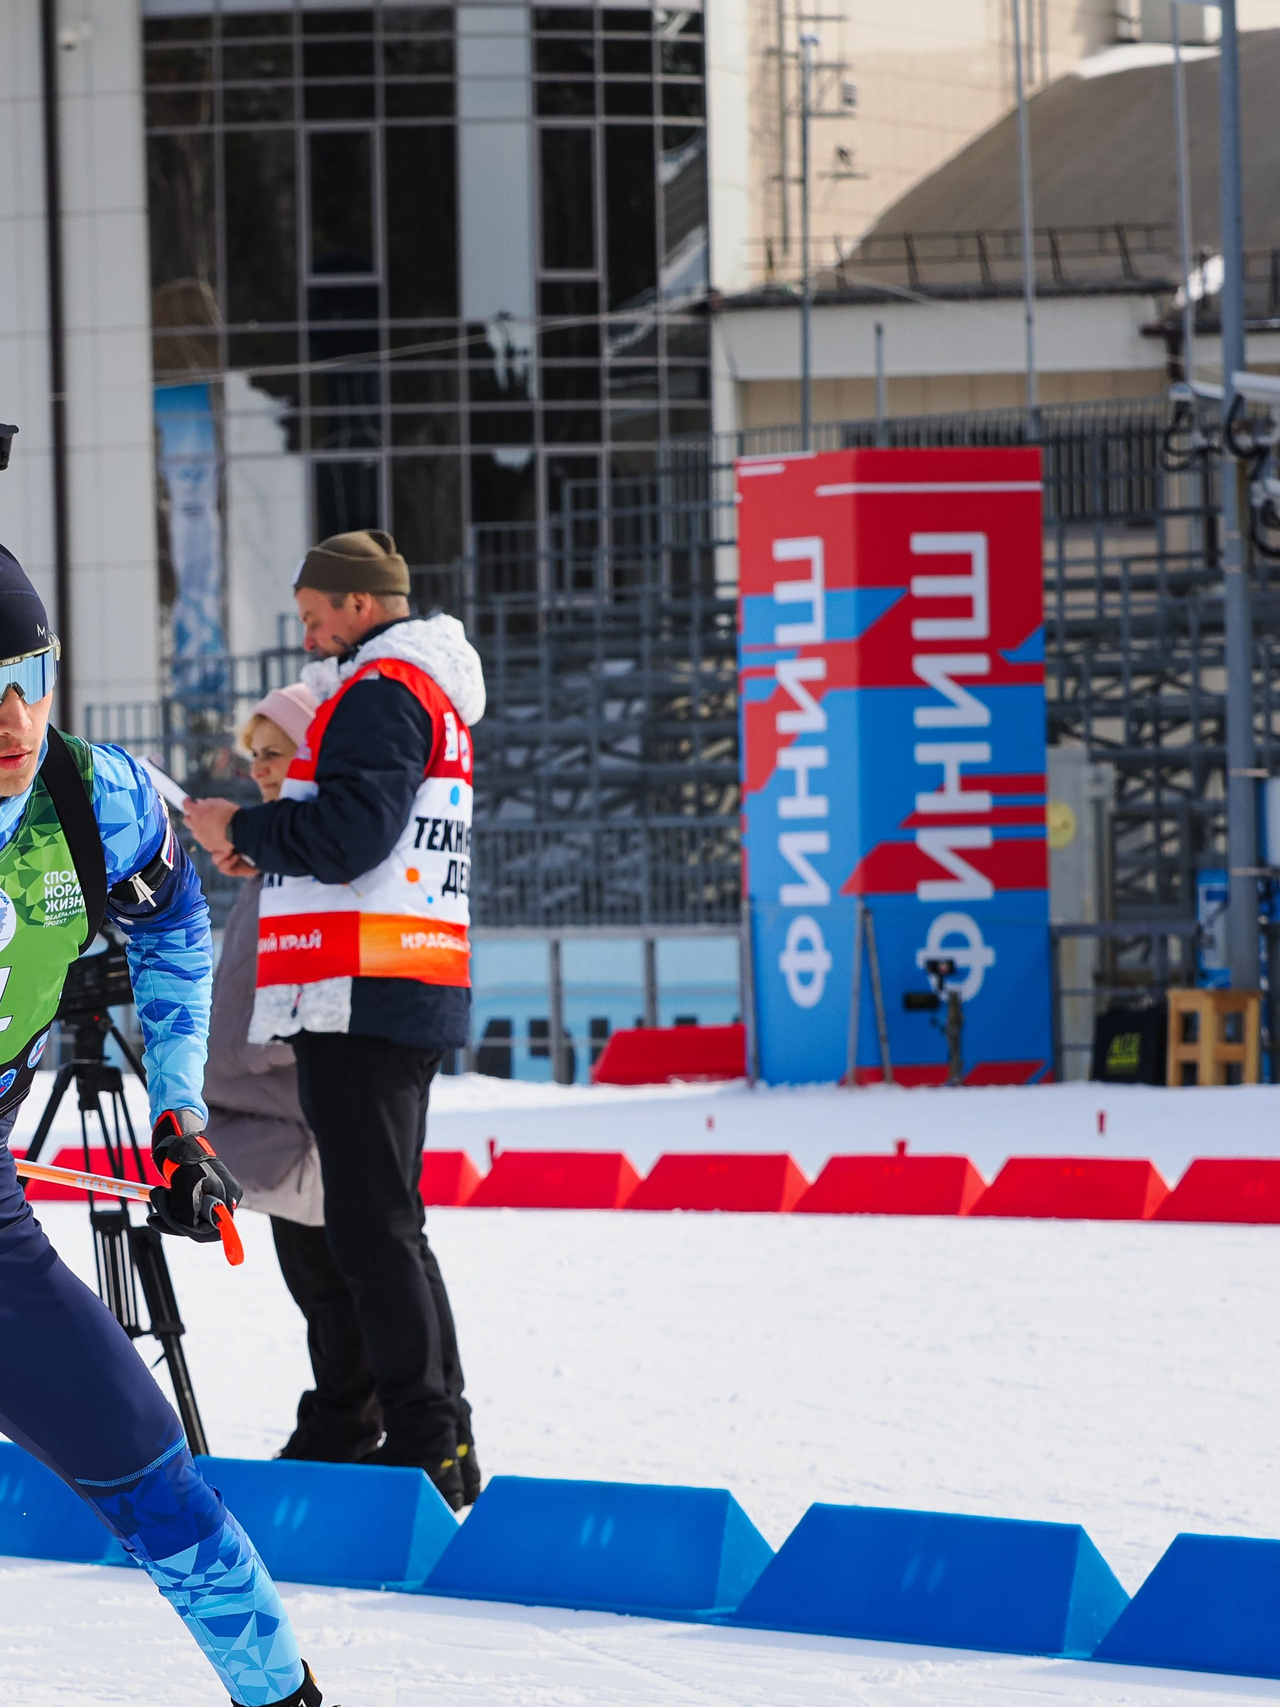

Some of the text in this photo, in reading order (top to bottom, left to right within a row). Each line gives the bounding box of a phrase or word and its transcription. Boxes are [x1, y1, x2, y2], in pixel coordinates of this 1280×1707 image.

[771, 536, 832, 1008] ФИНИШ
[909, 532, 996, 1003] ФИНИШ
[414, 816, 471, 854] ТЕХН
[43, 869, 79, 885] СПОР
[44, 882, 83, 900] НОРМ
[279, 928, 322, 952] КРАЙ
